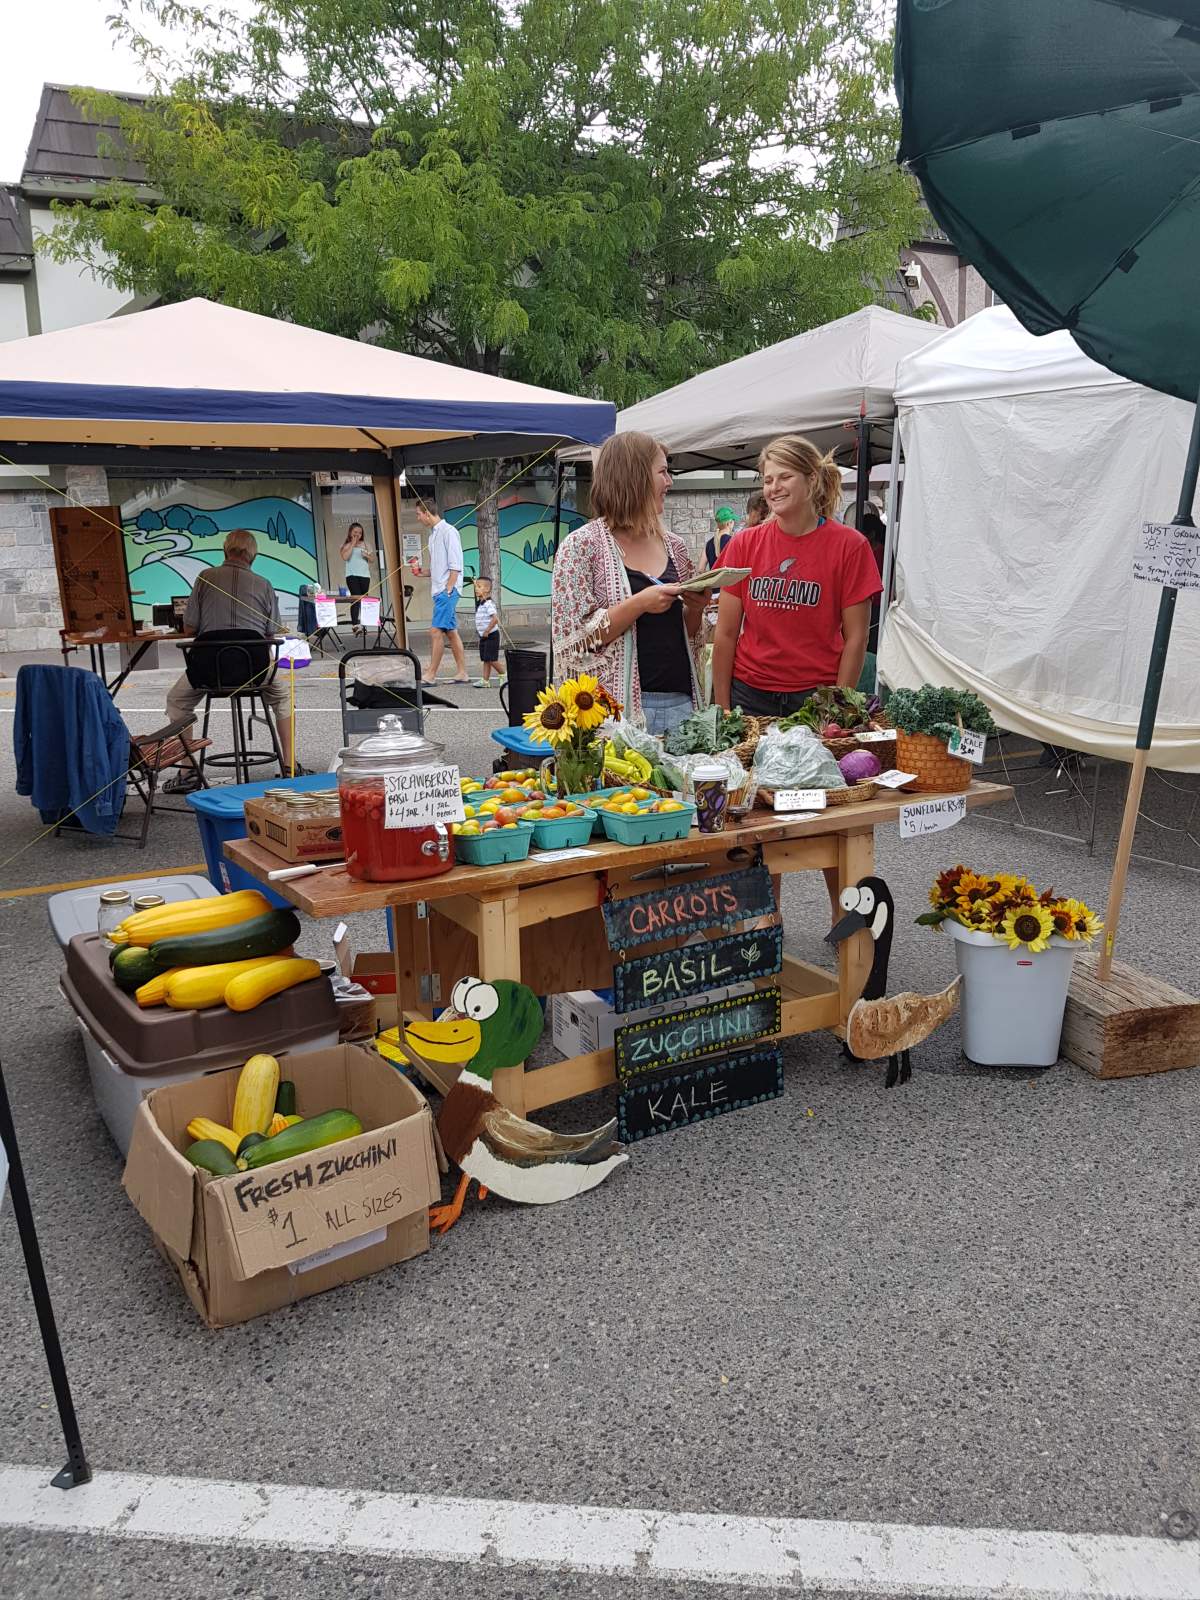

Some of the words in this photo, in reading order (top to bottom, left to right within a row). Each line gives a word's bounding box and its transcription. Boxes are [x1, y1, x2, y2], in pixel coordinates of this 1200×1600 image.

[1143, 523, 1170, 536] JUST
[1133, 563, 1144, 571] No
[963, 736, 984, 749] KALE
[388, 769, 455, 793] STRAWBERRY
[413, 787, 460, 803] LEMONADE
[903, 800, 957, 819] SUNFLOWERS
[629, 885, 738, 934] CARROTS
[648, 1080, 729, 1121] KALE
[234, 1164, 314, 1213] FRESH
[325, 1204, 356, 1231] ALL
[362, 1187, 403, 1219] SIZES
